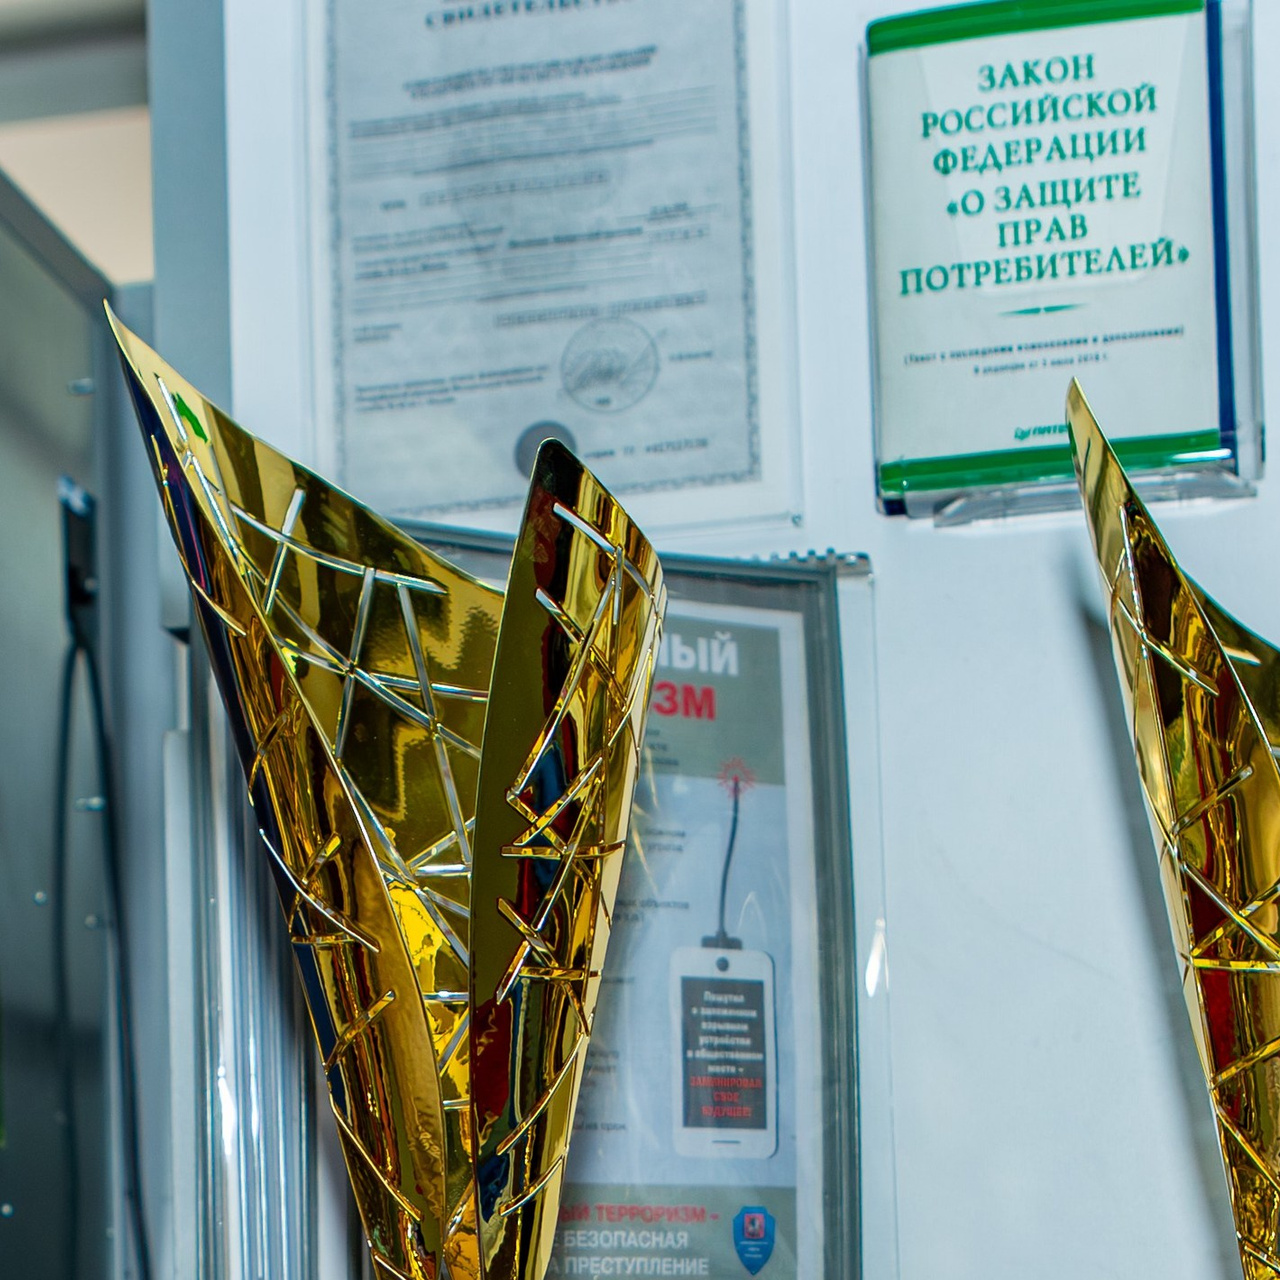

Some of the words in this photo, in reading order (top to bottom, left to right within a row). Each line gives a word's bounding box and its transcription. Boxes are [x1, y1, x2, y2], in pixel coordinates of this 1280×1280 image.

[978, 53, 1094, 92] ЗАКОН
[922, 83, 1156, 138] РОССИЙСКОЙ
[933, 126, 1146, 176] ФЕДЕРАЦИИ
[946, 190, 984, 217] «О
[994, 172, 1141, 214] ЗАЩИТЕ
[998, 214, 1087, 248] ПРАВ
[899, 237, 1190, 296] ПОТРЕБИТЕЛЕЙ»
[596, 1203, 706, 1224] ТЕРРОРИЗМ
[564, 1230, 688, 1248] БЕЗОПАСНАЯ
[565, 1257, 709, 1277] ПРЕСТУПЛЕНИЕ
